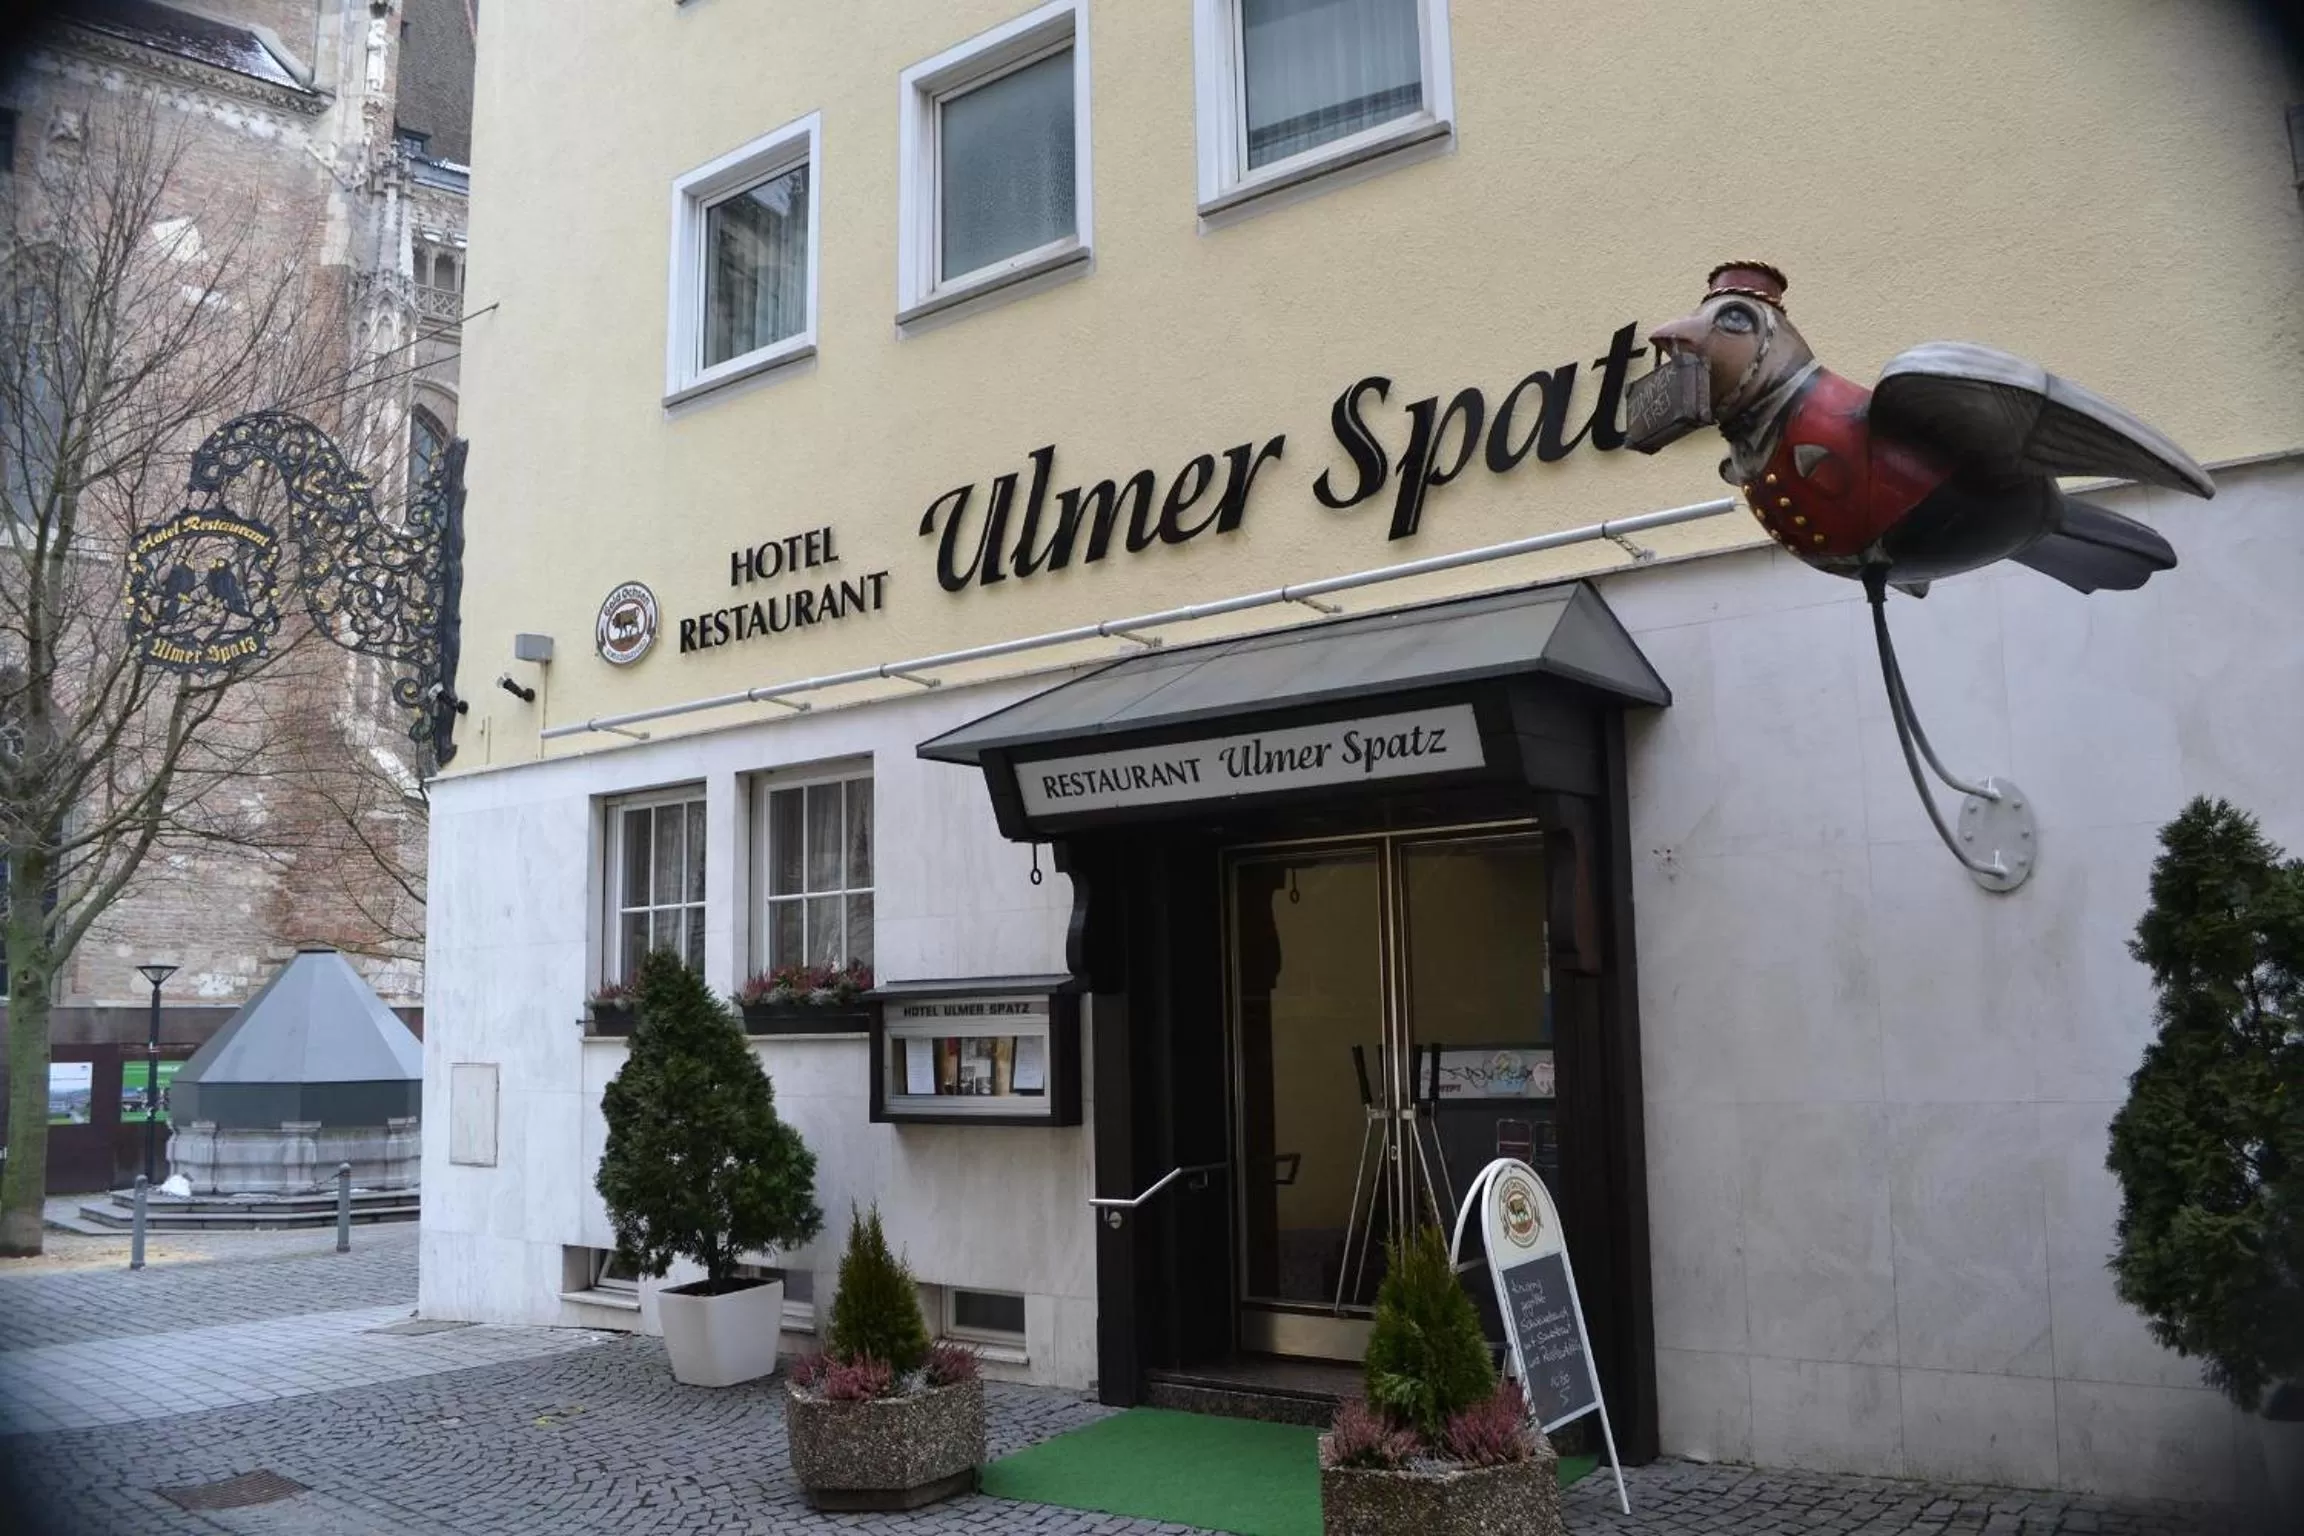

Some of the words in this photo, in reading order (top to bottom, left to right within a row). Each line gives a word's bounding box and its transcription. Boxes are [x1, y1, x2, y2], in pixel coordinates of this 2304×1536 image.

[1627, 364, 1677, 425] ZIMMER
[1642, 390, 1671, 431] FREI
[918, 433, 1286, 593] Ulmer
[1312, 321, 1648, 542] Spat
[137, 521, 179, 554] Hotel
[182, 515, 270, 547] Restaurant
[731, 526, 839, 586] HOTEL
[679, 570, 889, 653] RESTAURANT
[150, 637, 202, 664] Ulmer
[204, 635, 258, 665] Spatz
[1042, 758, 1201, 799] RESTAURANT
[1219, 739, 1332, 778] Ulmer
[1340, 725, 1448, 772] Spatz
[903, 1005, 939, 1017] HOTEL
[943, 1004, 984, 1016] ULMER
[988, 1002, 1030, 1015] SPATZ
